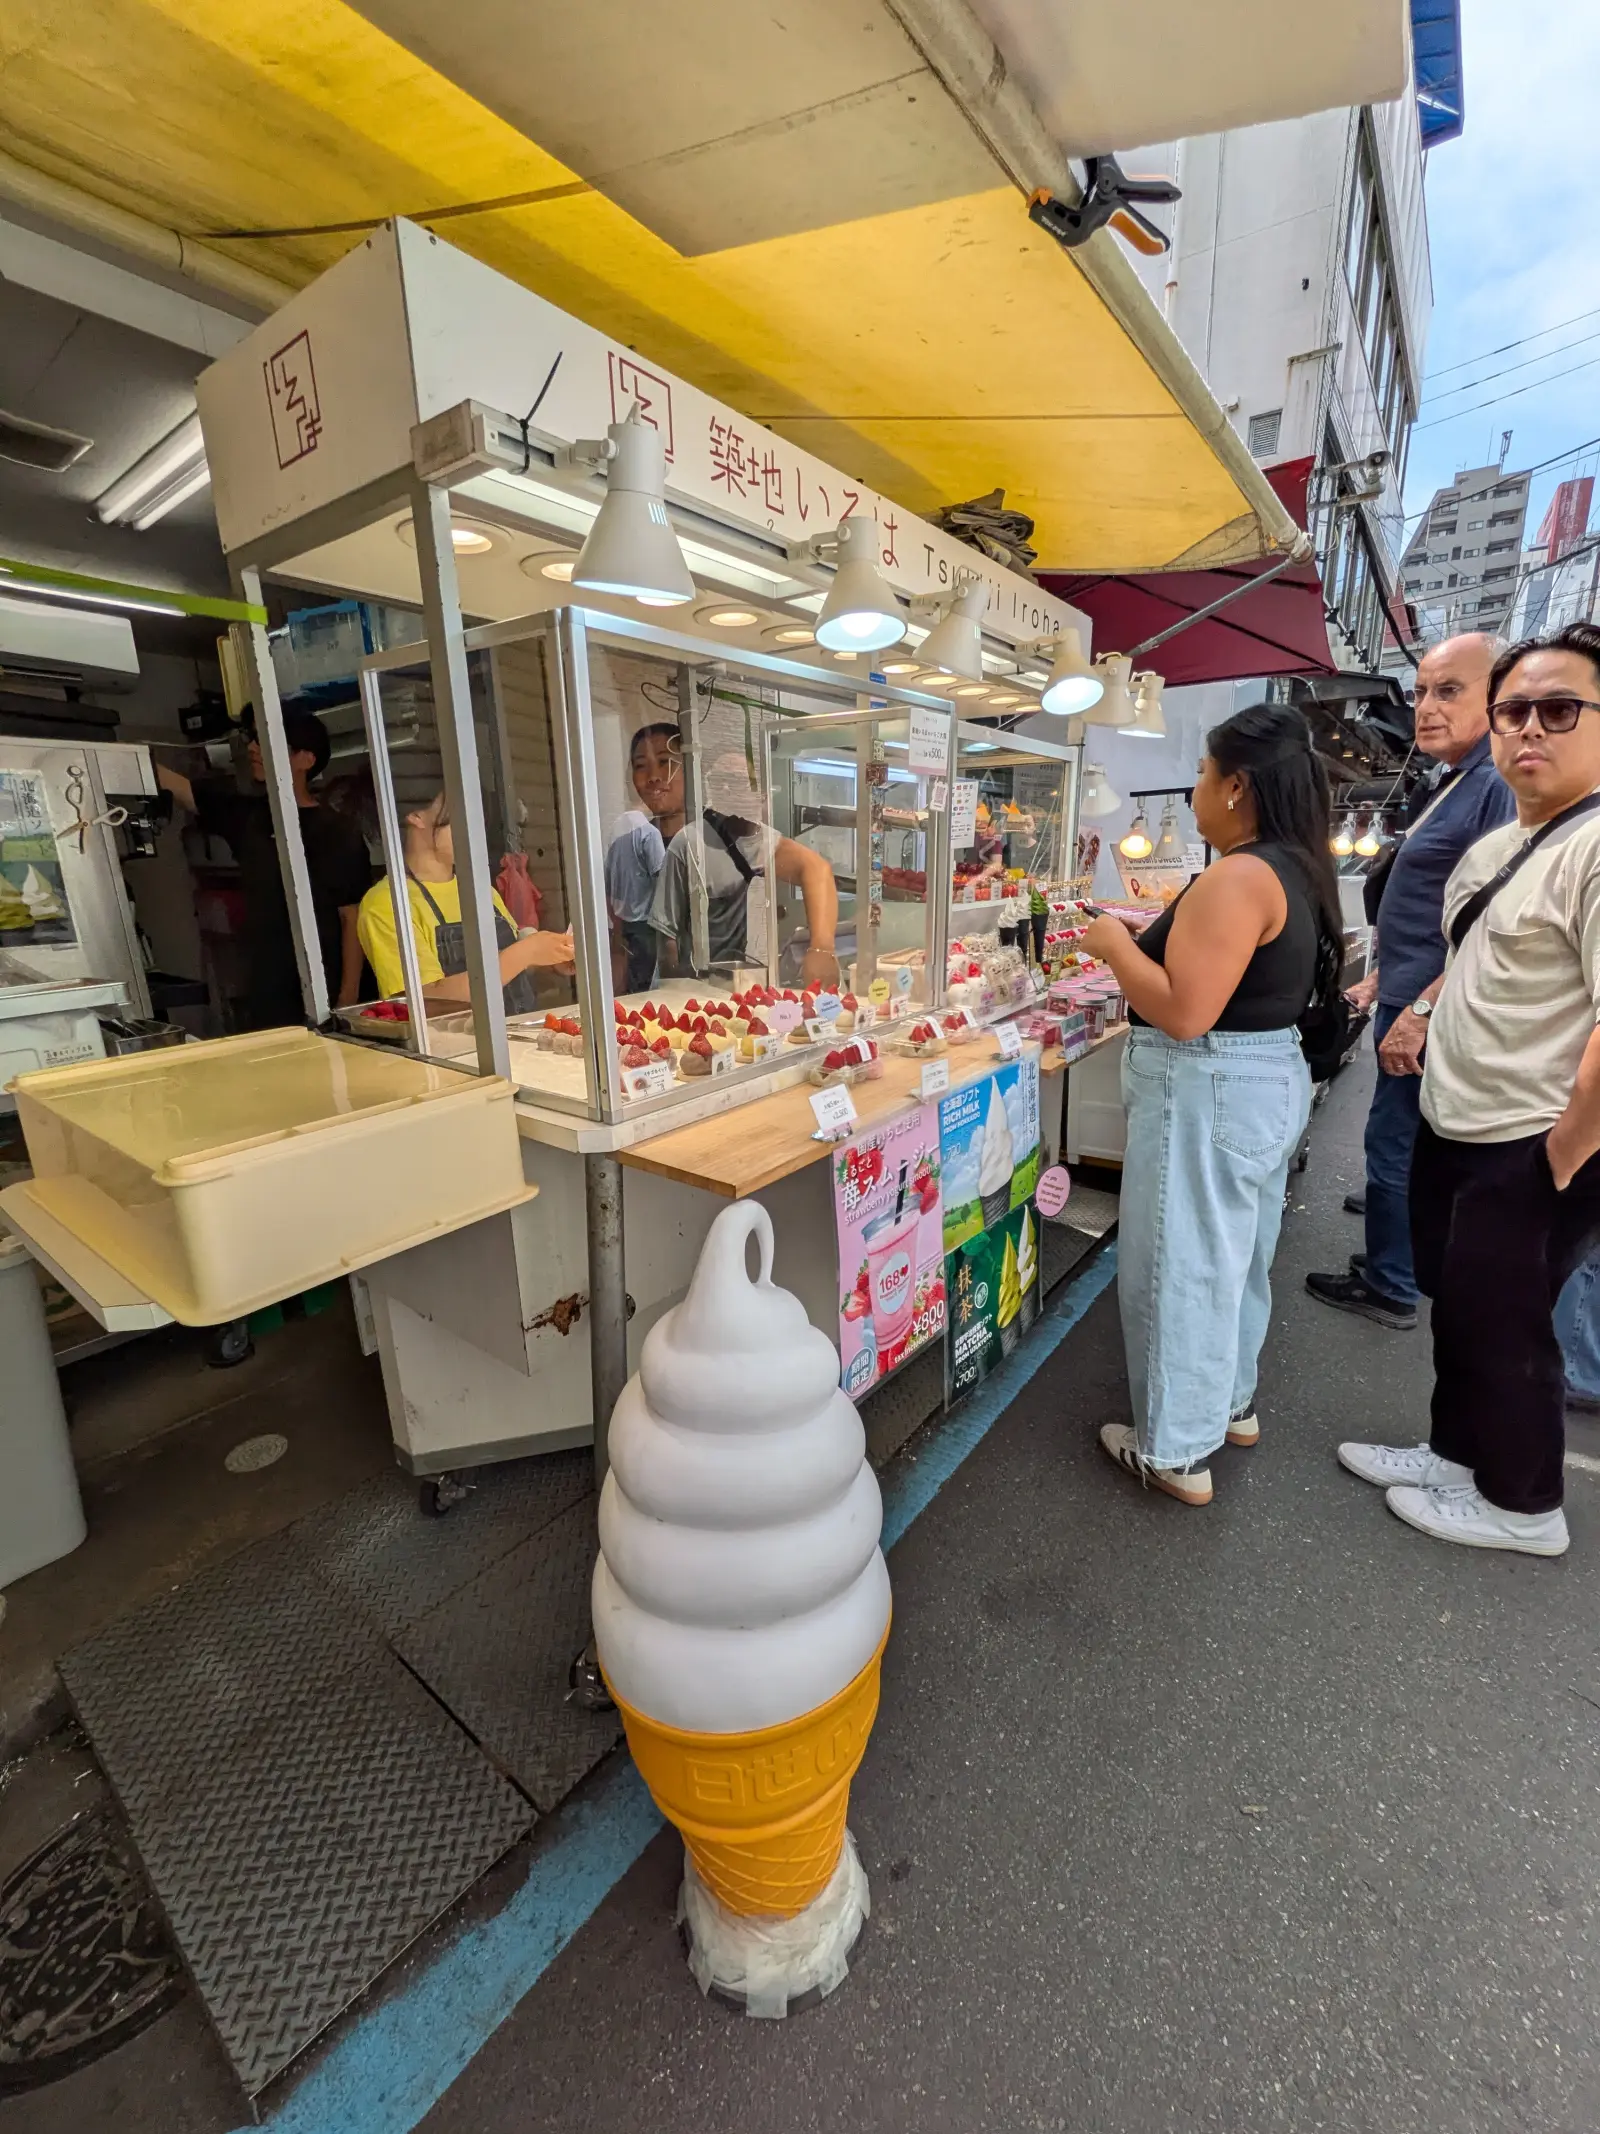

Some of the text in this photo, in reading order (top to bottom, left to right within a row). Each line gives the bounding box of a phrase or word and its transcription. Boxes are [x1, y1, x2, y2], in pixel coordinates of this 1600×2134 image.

[1013, 592, 1060, 636] Iroha
[943, 1099, 980, 1127] RICH MILK
[840, 1141, 940, 1212] 苺スムージー
[842, 1156, 873, 1183] まるごと
[845, 1195, 885, 1225] strawberry
[879, 1269, 901, 1294] 168
[958, 1264, 973, 1327] 抹茶
[912, 1299, 945, 1337] ¥800
[954, 1326, 988, 1359] MATCHA
[894, 1350, 906, 1364] tax
[955, 1350, 970, 1367] FROM
[851, 1367, 870, 1392] 限定
[955, 1366, 976, 1389] ¥700
